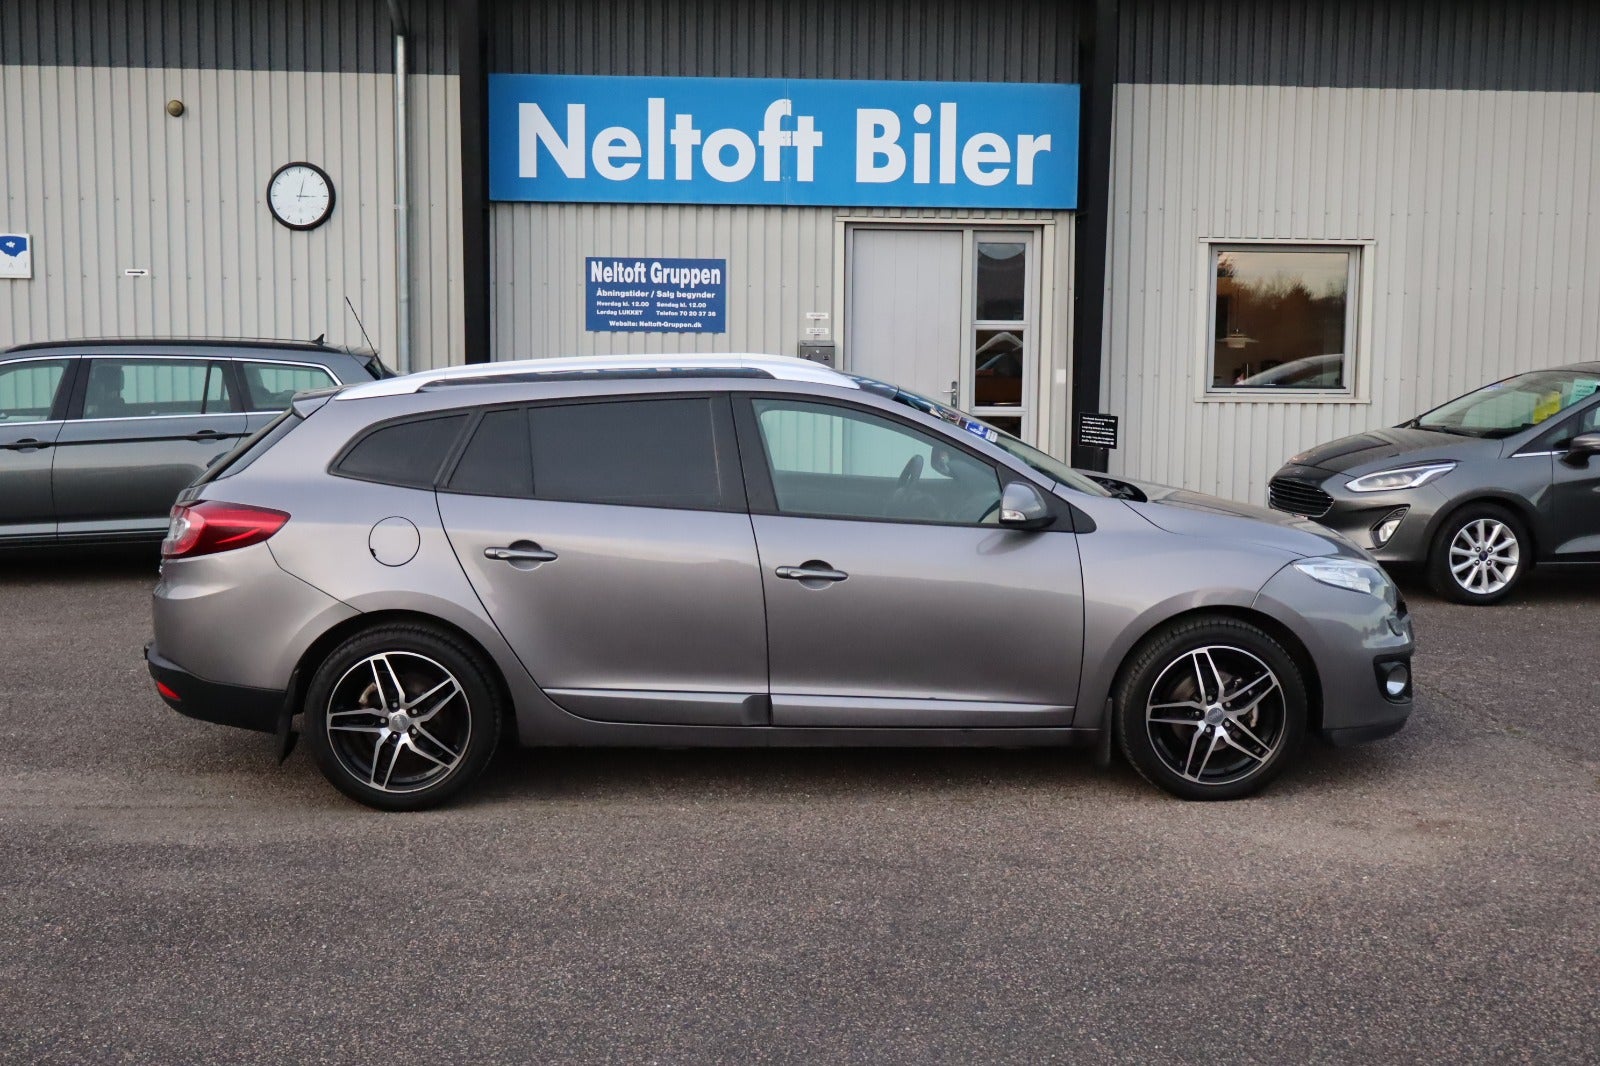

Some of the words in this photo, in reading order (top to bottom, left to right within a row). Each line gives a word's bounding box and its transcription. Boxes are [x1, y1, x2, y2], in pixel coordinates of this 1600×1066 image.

[518, 97, 823, 183] Neltoft
[855, 102, 1051, 187] Biler
[590, 260, 647, 284] Neltoft
[650, 261, 721, 289] Gruppen
[596, 288, 650, 299] Åbningstider
[656, 290, 675, 300] Salg
[676, 290, 716, 300] begynder
[688, 310, 698, 318] 20
[608, 320, 638, 328] Website:
[638, 321, 702, 329] Neltoft-Gruppen.dk
